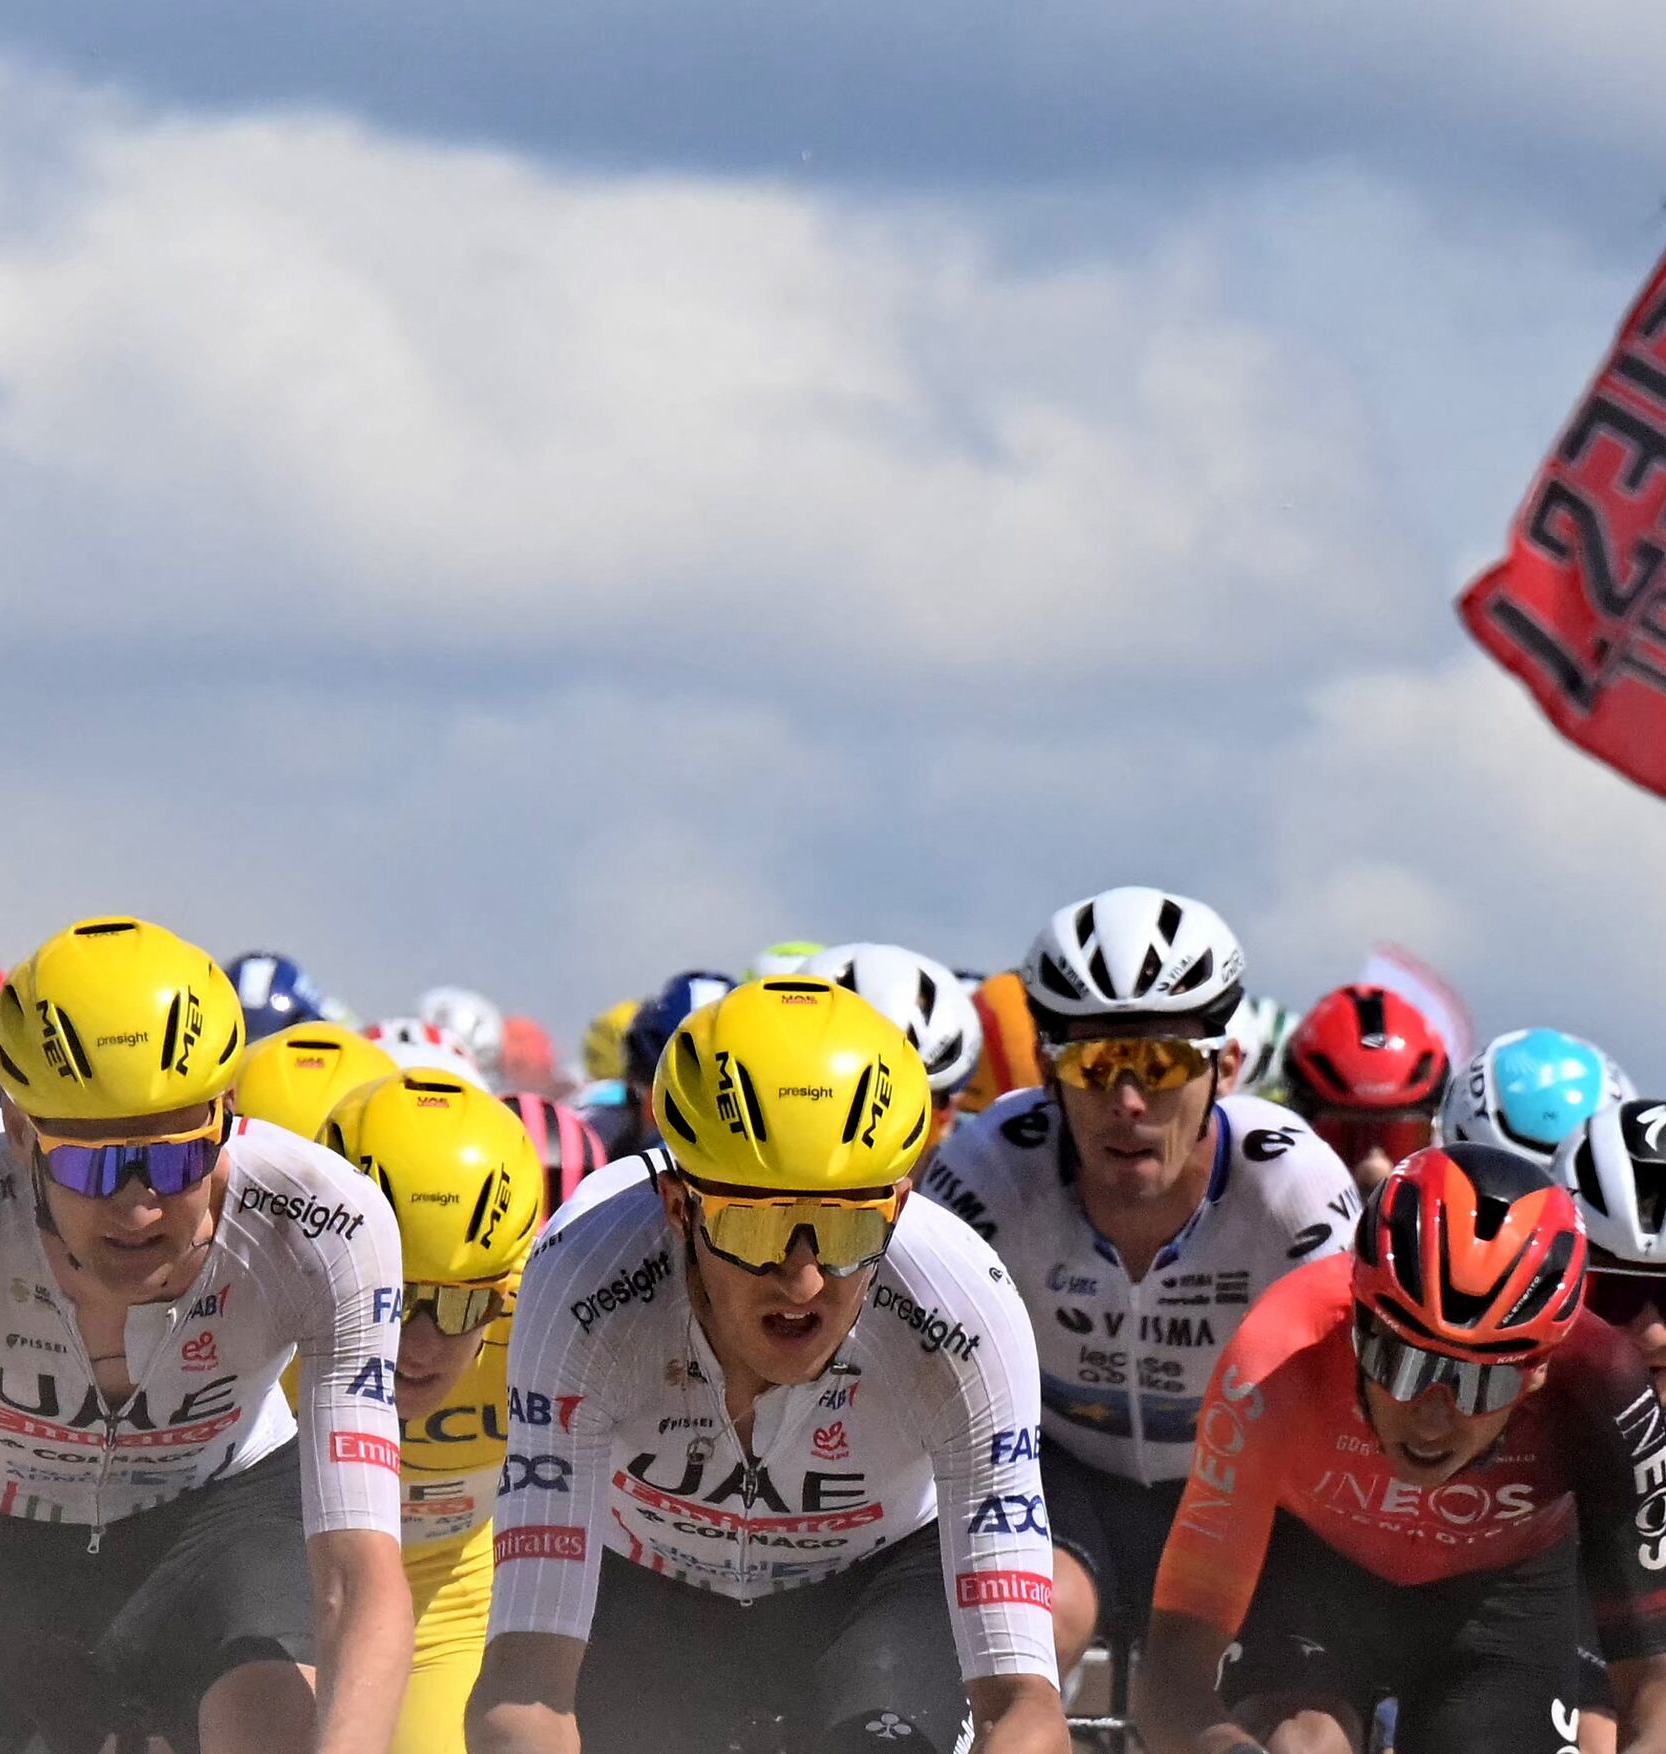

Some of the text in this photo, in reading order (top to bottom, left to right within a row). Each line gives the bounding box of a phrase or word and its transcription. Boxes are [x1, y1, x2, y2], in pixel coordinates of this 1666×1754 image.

[36, 999, 80, 1081] MET
[96, 1029, 149, 1050] presight
[174, 985, 203, 1077] MET
[714, 1051, 749, 1141] MET
[778, 1085, 834, 1101] presight
[861, 1053, 892, 1149] MET
[237, 1185, 365, 1241] presight
[480, 1162, 512, 1251] MET
[570, 1251, 672, 1334] presight
[872, 1284, 981, 1361] presight
[1103, 1312, 1216, 1347] VISMA
[626, 1452, 869, 1514] UAE
[1180, 1363, 1265, 1542] INEOS
[1314, 1470, 1536, 1524] INEOS
